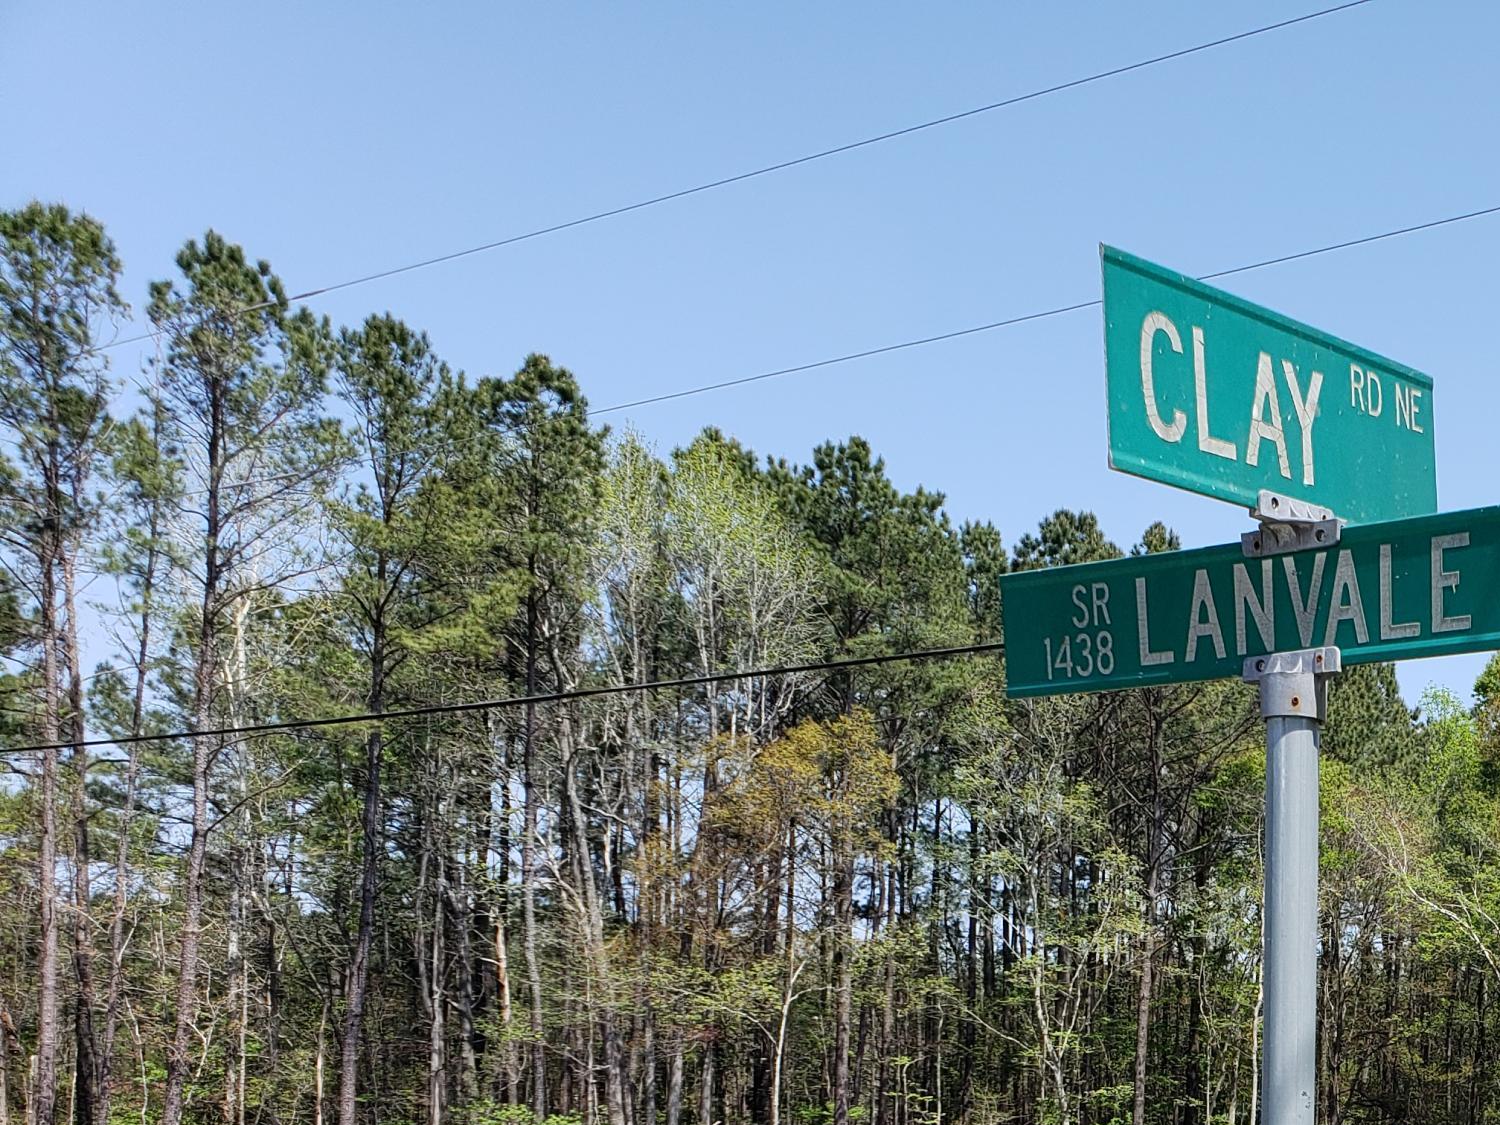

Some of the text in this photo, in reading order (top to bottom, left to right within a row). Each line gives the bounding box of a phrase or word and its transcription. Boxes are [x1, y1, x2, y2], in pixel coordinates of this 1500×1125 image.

[1139, 311, 1425, 486] CLAY RD NE
[1072, 582, 1111, 629] SR
[1135, 532, 1472, 666] LANVALE
[1044, 631, 1114, 680] 1438
